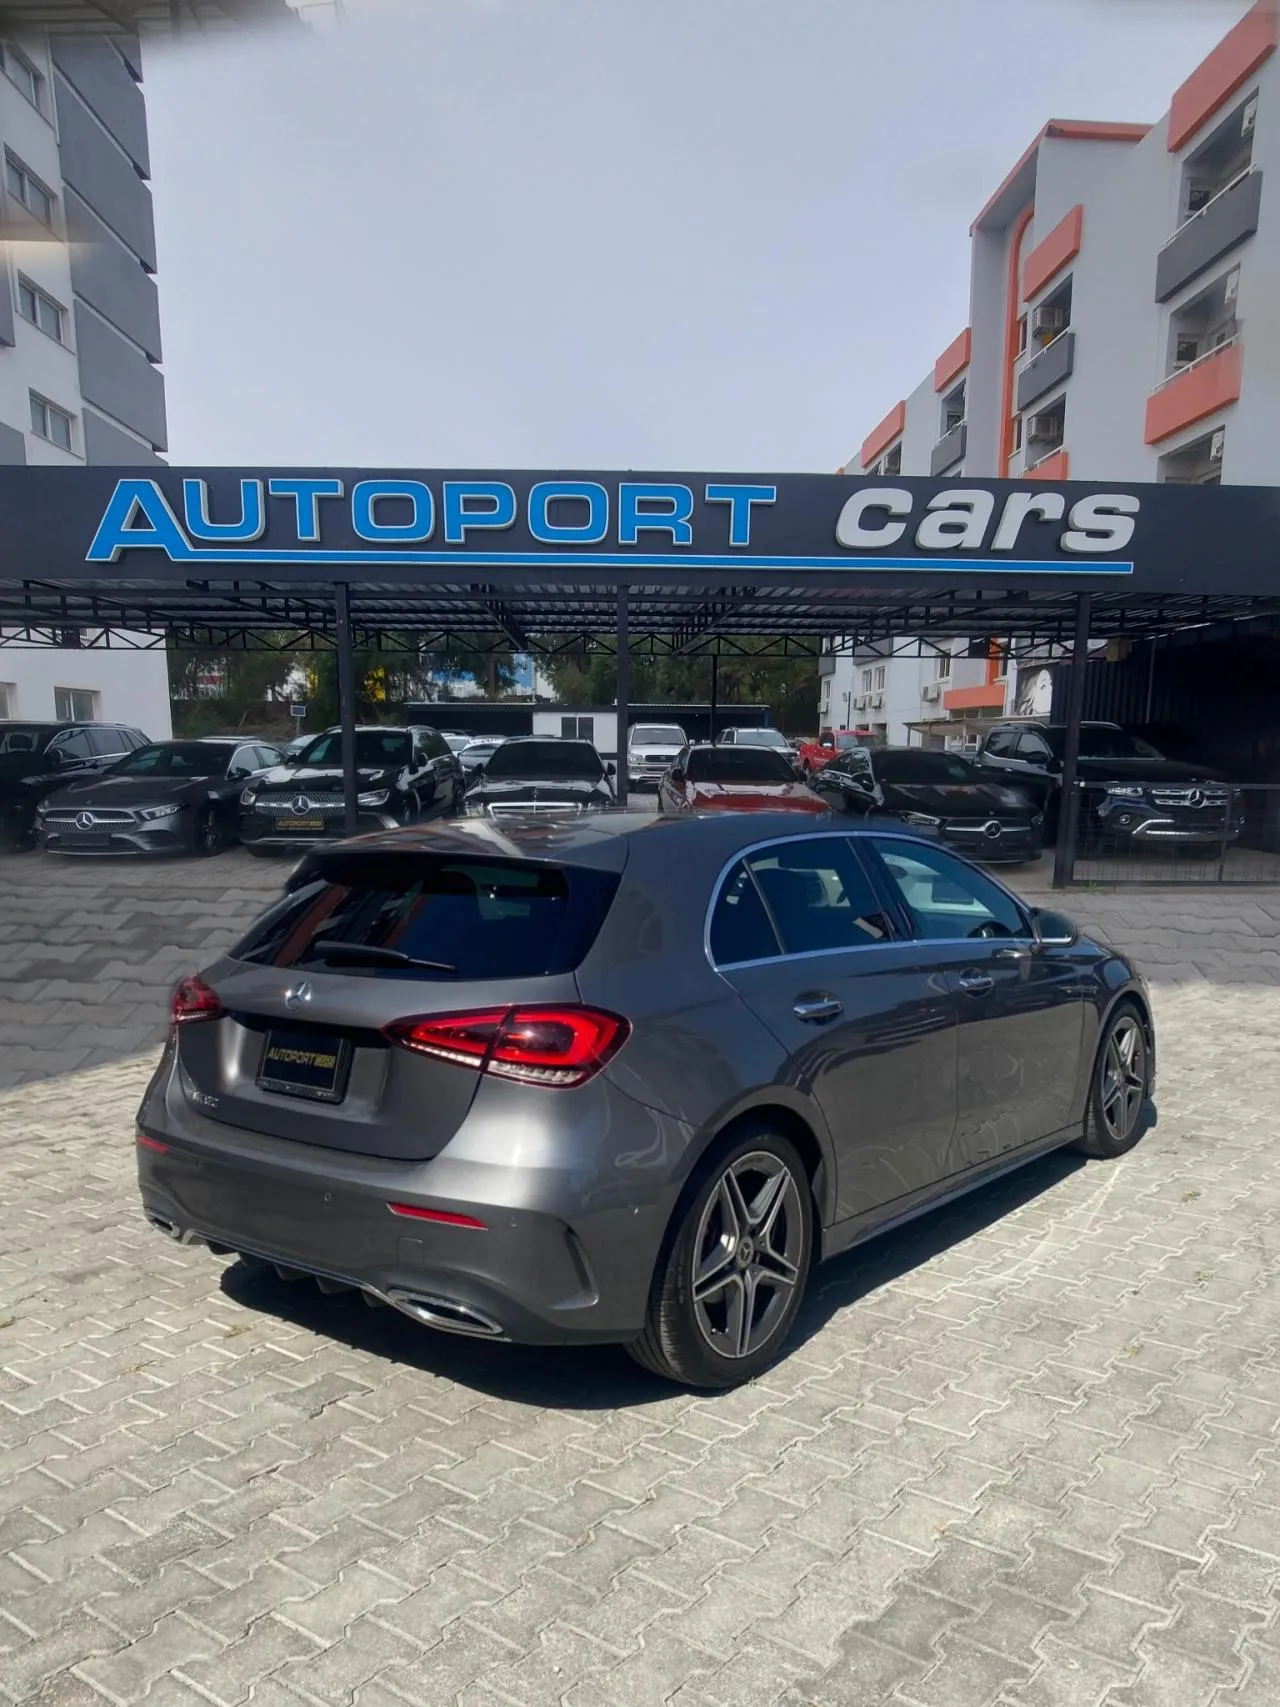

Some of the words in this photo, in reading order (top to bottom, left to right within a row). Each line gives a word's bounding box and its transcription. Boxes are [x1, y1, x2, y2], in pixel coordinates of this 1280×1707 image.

[86, 478, 777, 563] AUTOPORT
[835, 487, 1141, 553] cars
[268, 1048, 316, 1065] AUTOPORT
